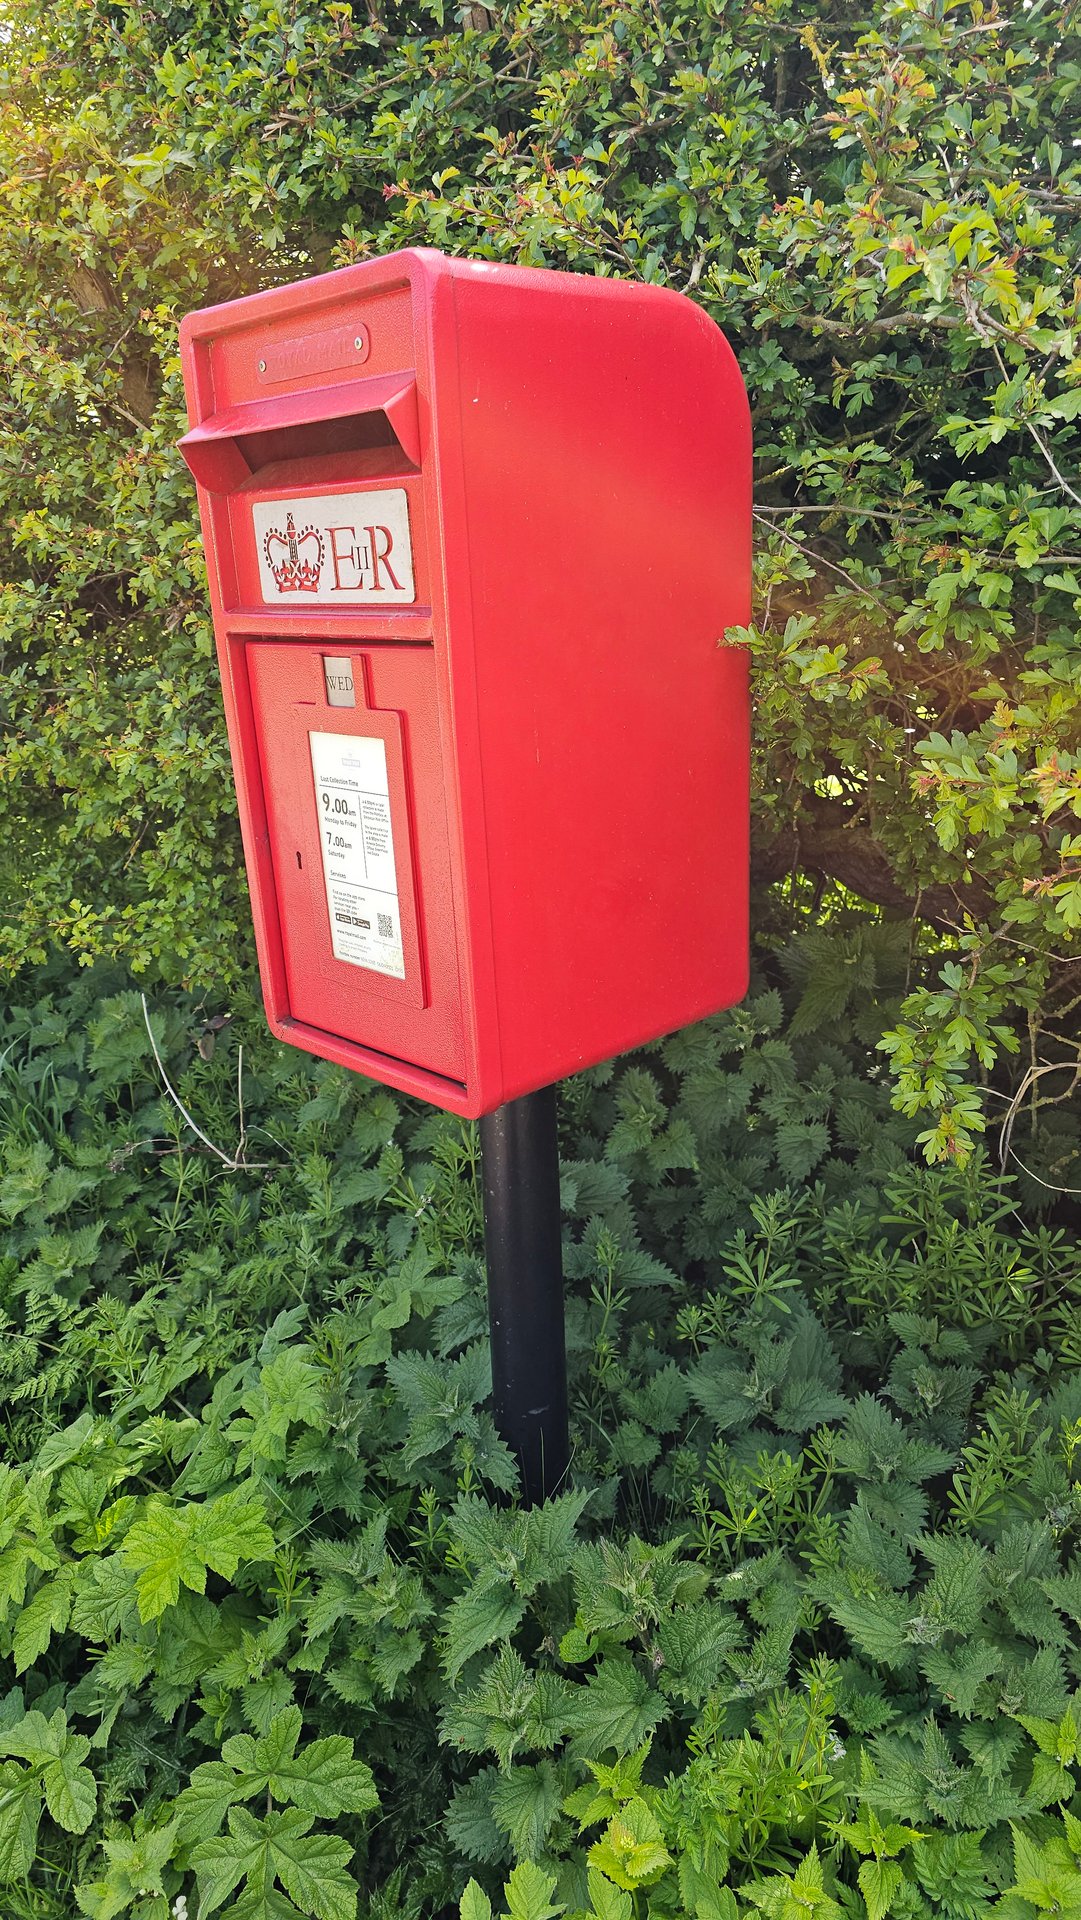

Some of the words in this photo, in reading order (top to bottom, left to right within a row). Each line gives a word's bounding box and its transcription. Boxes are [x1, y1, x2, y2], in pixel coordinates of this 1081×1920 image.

[326, 675, 354, 691] WED
[329, 777, 348, 785] Collection
[324, 816, 339, 825] Monday
[344, 820, 357, 828] Friday
[328, 849, 345, 860] Saturday
[330, 869, 347, 879] Services
